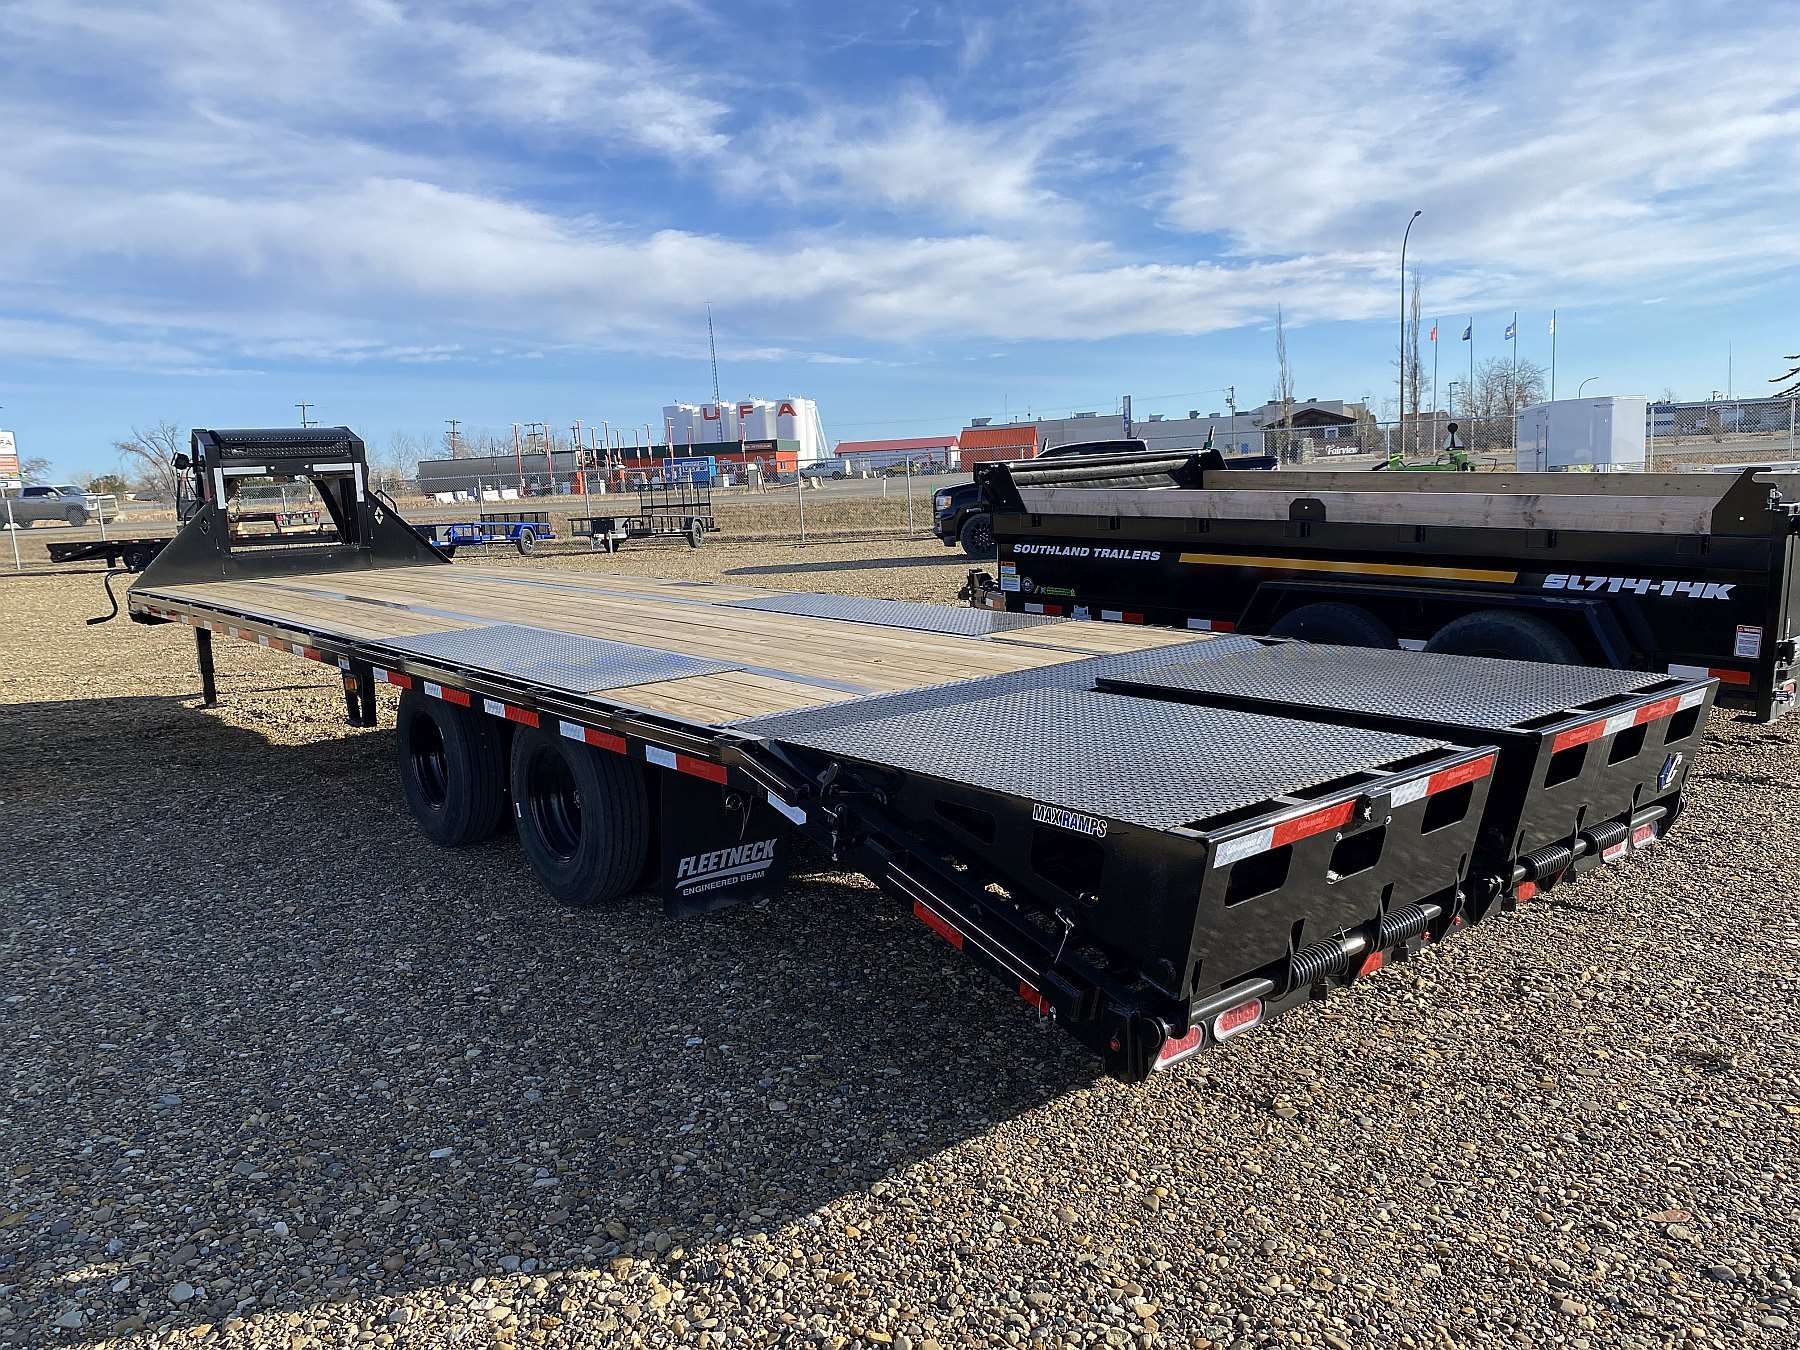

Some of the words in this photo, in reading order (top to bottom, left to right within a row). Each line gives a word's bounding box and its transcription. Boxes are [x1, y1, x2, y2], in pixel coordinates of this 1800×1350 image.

[1013, 543, 1090, 557] SOUTHLAND
[1093, 548, 1161, 561] TRAILERS
[1542, 573, 1737, 600] SL714-14K
[677, 838, 778, 879] FLEETNECK
[683, 877, 738, 896] ENGINEERED
[740, 870, 765, 882] BEAM
